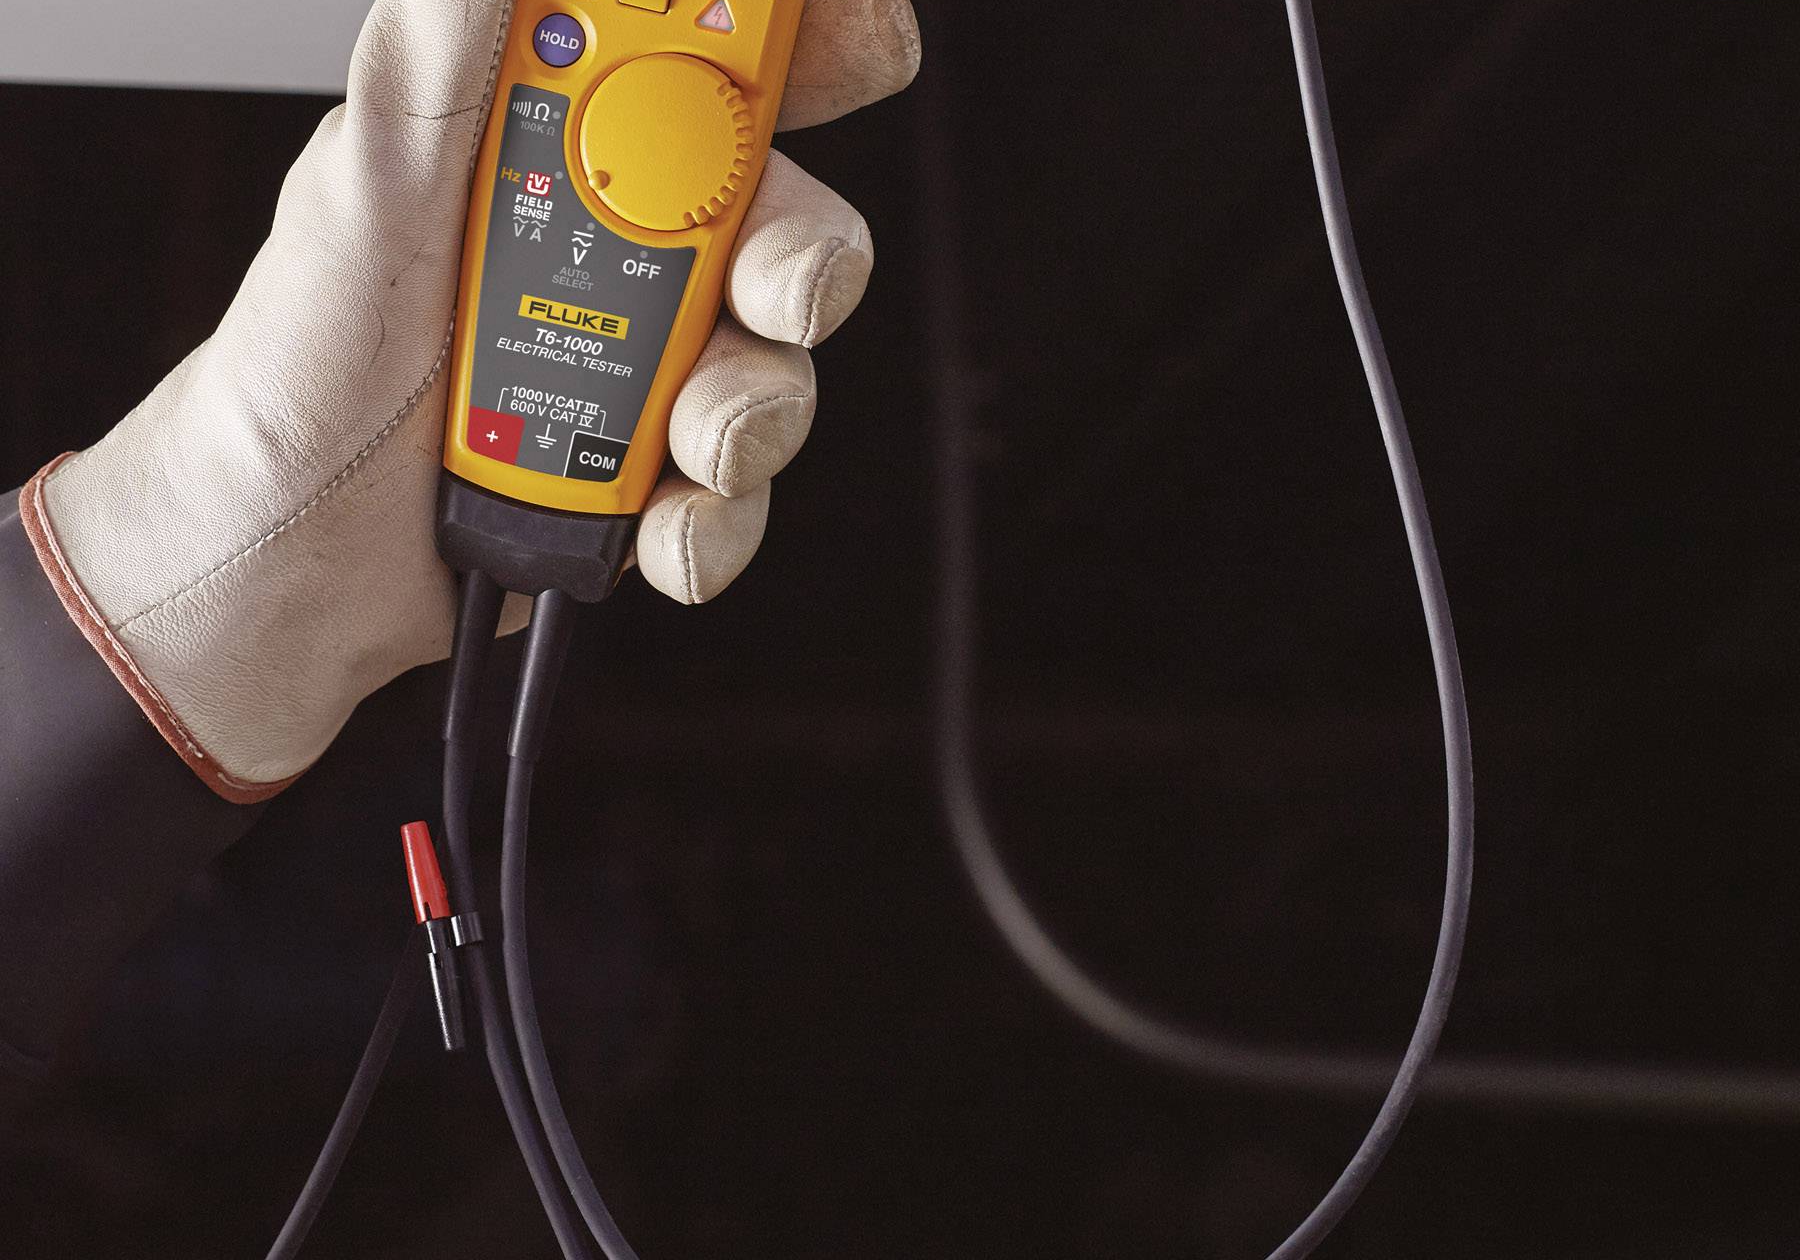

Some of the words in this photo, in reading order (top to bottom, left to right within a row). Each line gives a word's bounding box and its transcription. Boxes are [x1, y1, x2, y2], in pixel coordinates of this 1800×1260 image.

[539, 29, 580, 51] HOLD
[500, 167, 522, 183] Hz
[515, 193, 553, 211] FIELD
[513, 204, 551, 221] SENSE
[559, 266, 590, 281] AUTO
[622, 259, 662, 279] OFF
[551, 274, 595, 292] SELECT
[528, 300, 619, 334] FLUKE
[535, 328, 604, 356] T6-1000
[496, 337, 578, 366] ELECTRICAL
[582, 356, 633, 378] TESTER
[555, 396, 585, 412] CAT
[549, 408, 578, 424] CAT
[577, 414, 595, 428] IV
[579, 451, 617, 471] COM
